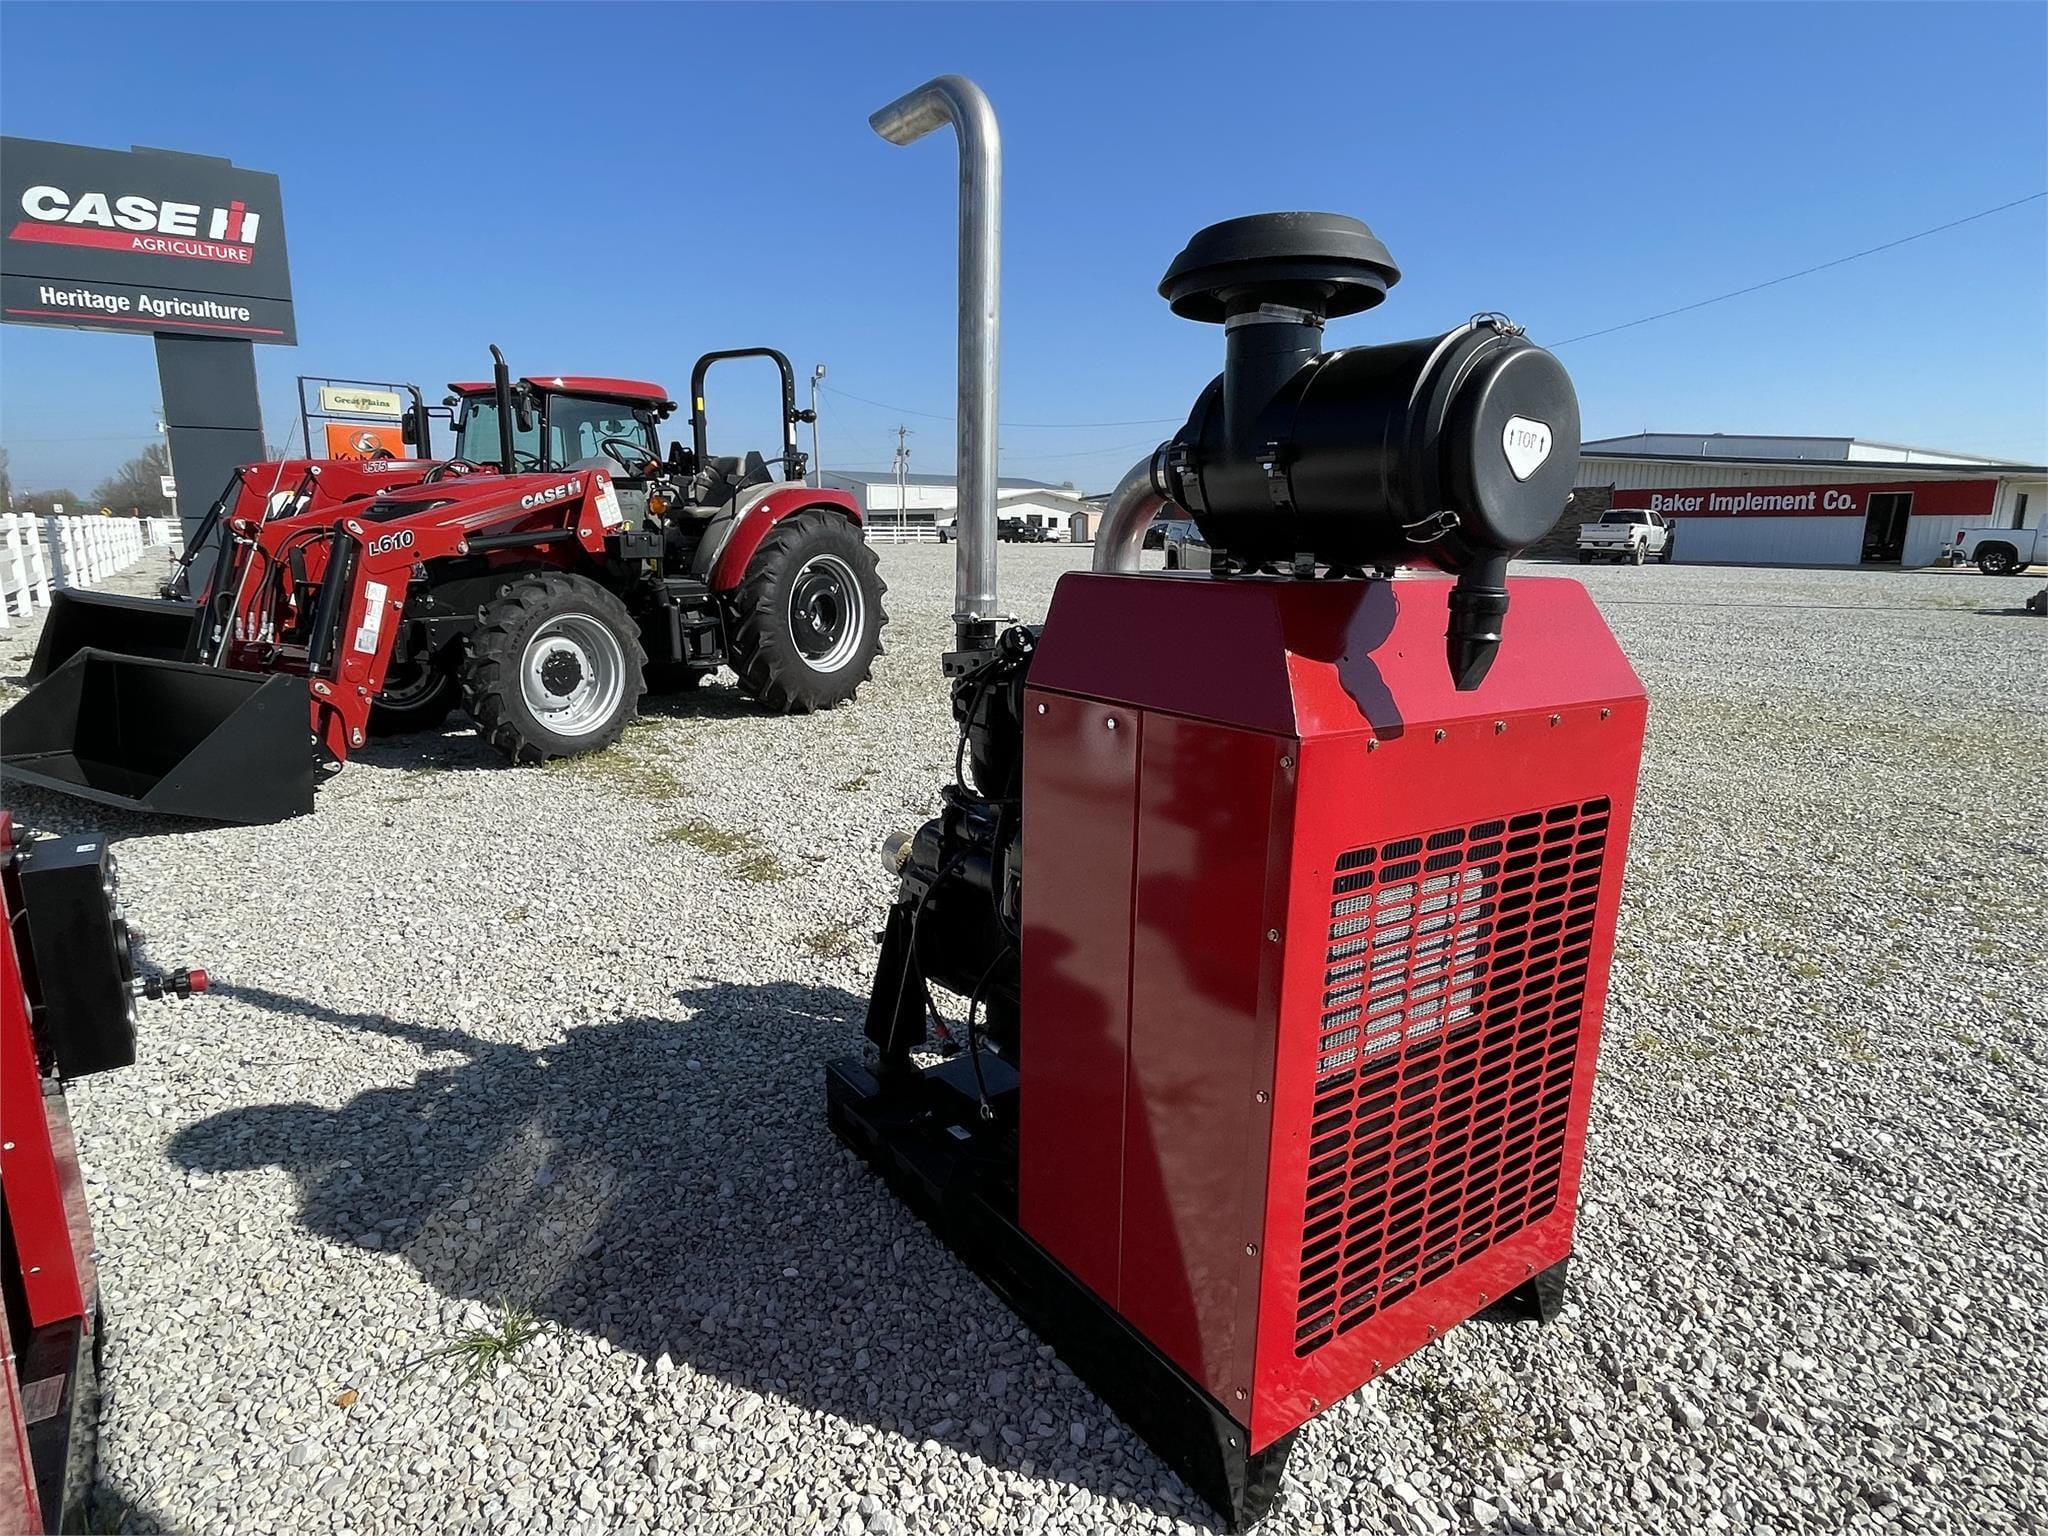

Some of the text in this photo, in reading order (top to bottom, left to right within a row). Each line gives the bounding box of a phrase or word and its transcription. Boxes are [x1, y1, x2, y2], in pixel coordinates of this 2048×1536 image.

[21, 185, 200, 236] CASE
[132, 236, 249, 262] AGRICULTURE
[39, 285, 250, 322] Heritage Agriculture
[334, 395, 390, 408] Great Plains
[1517, 429, 1538, 449] TOP
[363, 461, 388, 473] L575
[521, 484, 566, 509] CASE
[1651, 489, 1857, 515] Baker Implement Co.
[369, 530, 414, 556] L610
